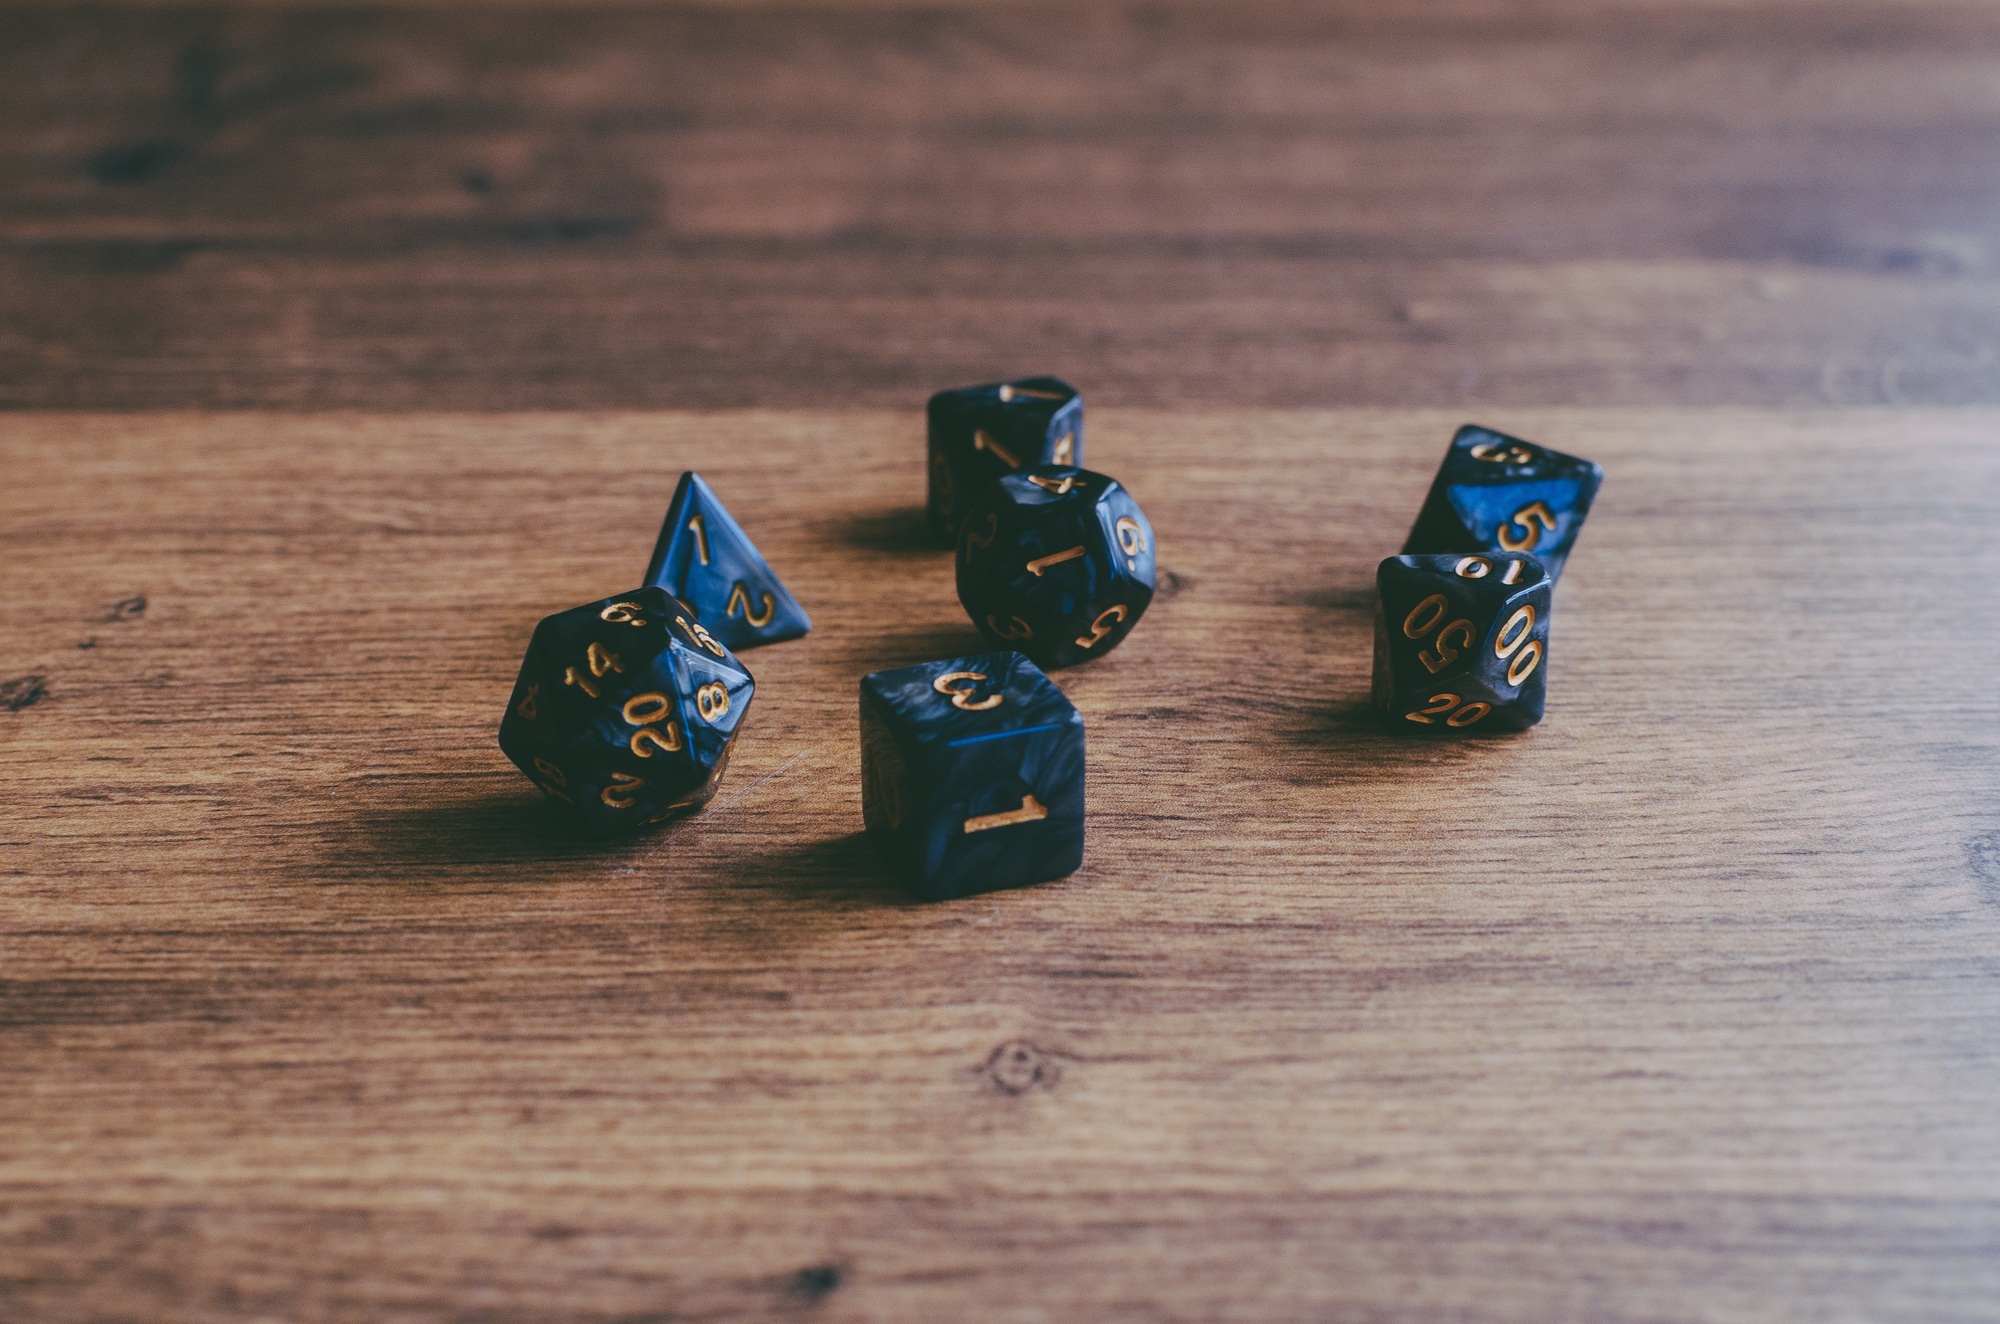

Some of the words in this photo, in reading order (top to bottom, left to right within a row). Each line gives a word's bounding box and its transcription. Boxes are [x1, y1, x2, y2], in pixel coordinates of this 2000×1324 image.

[1470, 444, 1532, 465] 3
[1028, 475, 1087, 494] 4
[689, 515, 711, 565] 1
[1498, 501, 1556, 552] 5
[1026, 545, 1086, 577] 1
[727, 579, 776, 628] 2
[1075, 604, 1128, 648] 5
[1403, 593, 1476, 674] 50
[1494, 604, 1542, 687] 00
[564, 642, 623, 698] 14
[697, 681, 730, 722] 8
[934, 672, 1003, 711] 3
[1405, 693, 1491, 727] 20
[622, 692, 682, 758] 20
[601, 772, 646, 809] 2
[964, 794, 1048, 834] 1
